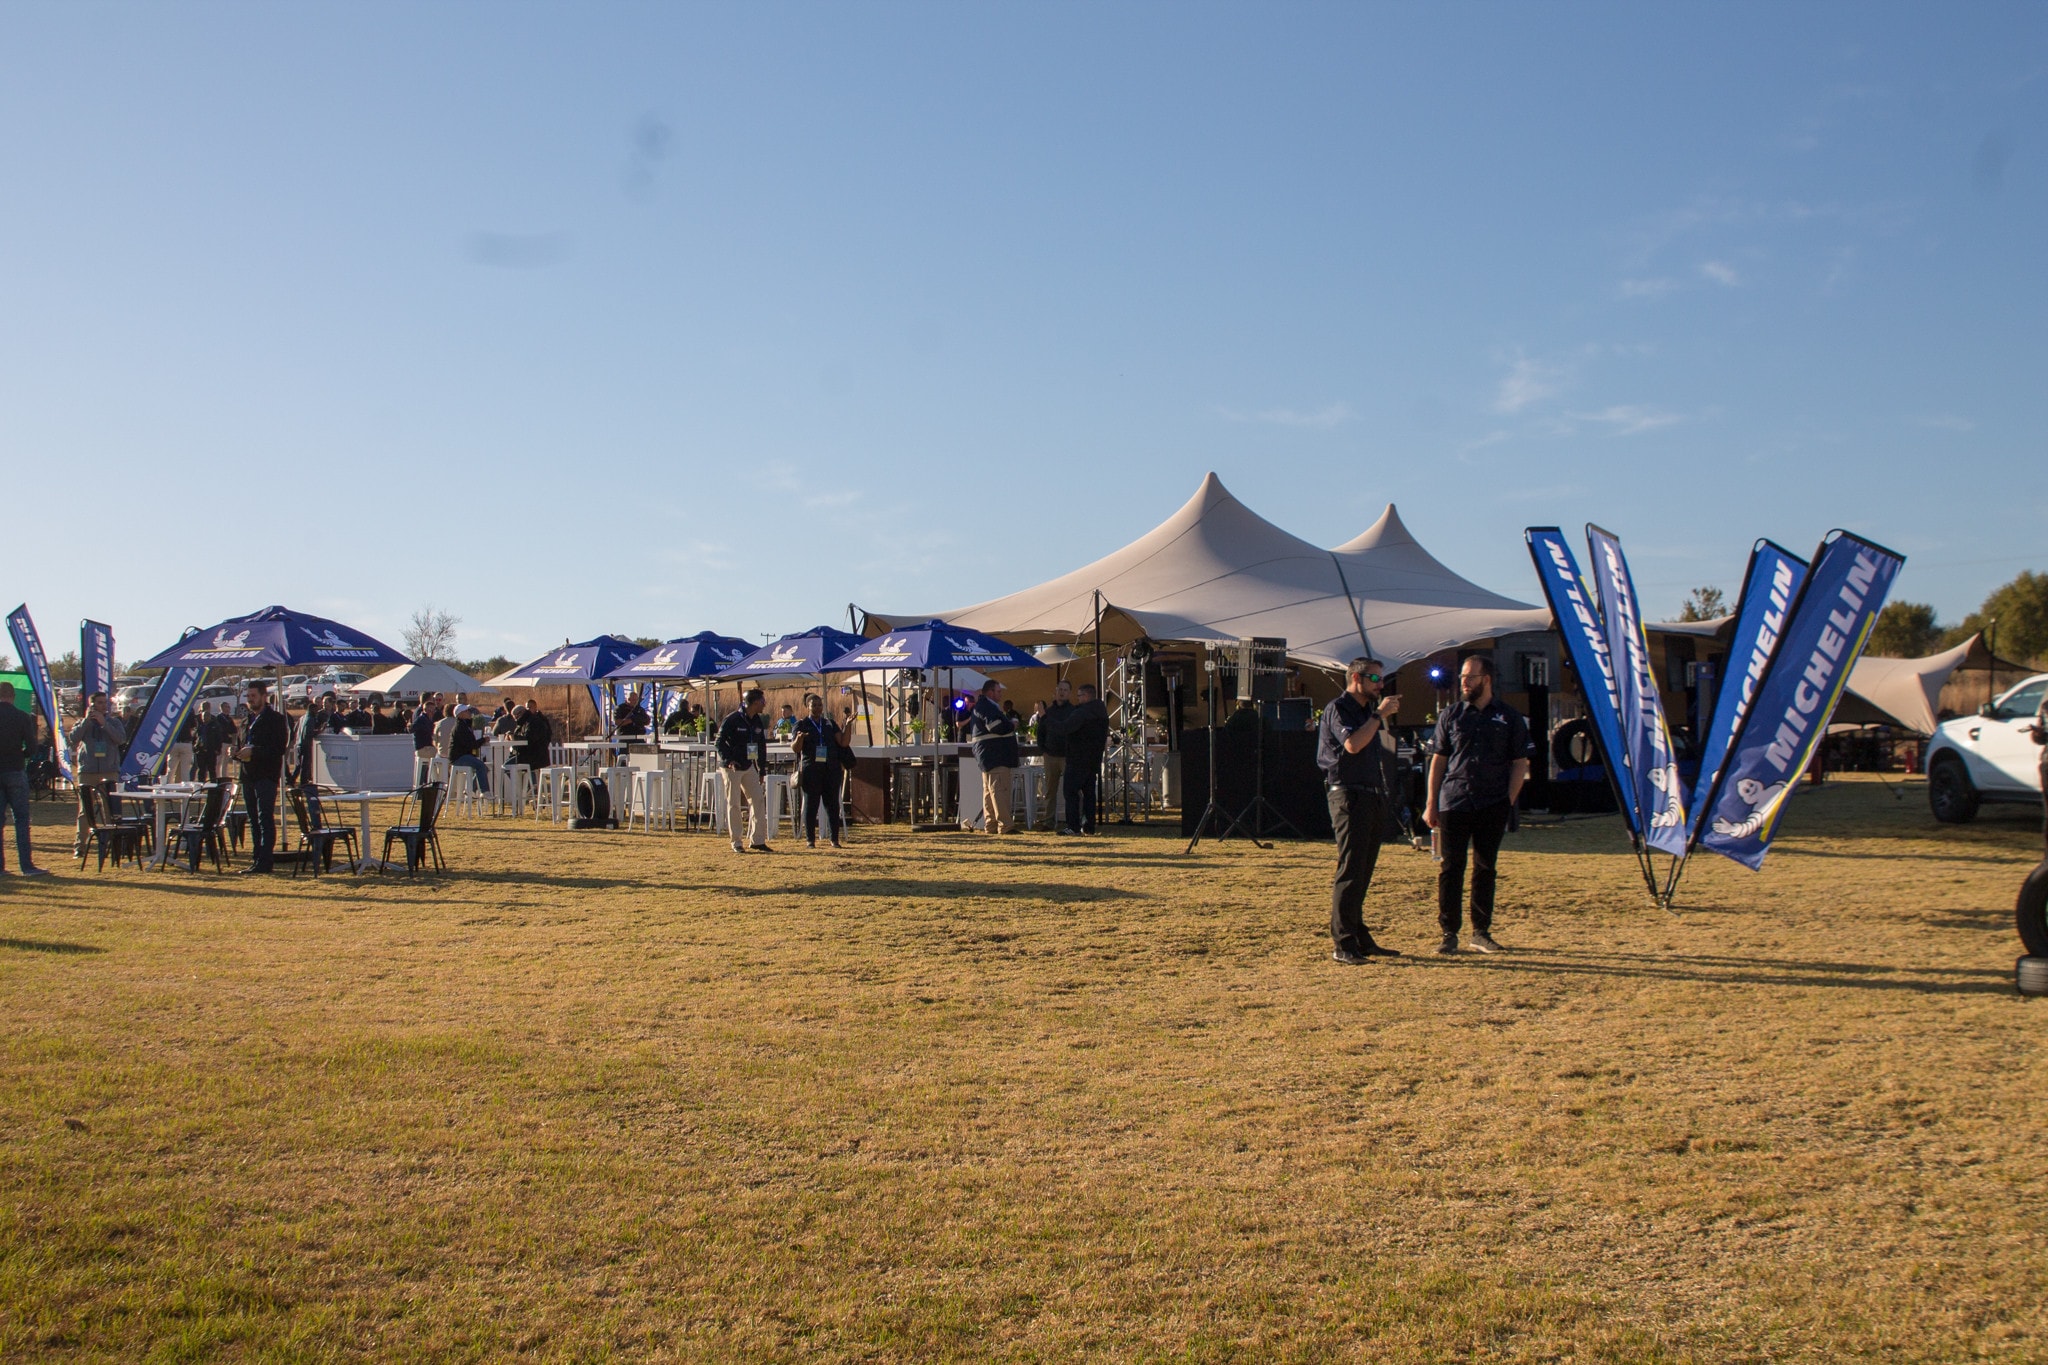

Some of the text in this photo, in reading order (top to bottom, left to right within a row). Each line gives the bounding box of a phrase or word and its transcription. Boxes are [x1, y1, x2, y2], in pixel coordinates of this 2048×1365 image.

[95, 628, 109, 693] HELIN
[180, 650, 261, 660] MICHELIN
[746, 662, 804, 670] MICHELIN
[1765, 552, 1877, 773] MICHELIN
[151, 667, 199, 748] MICHEL
